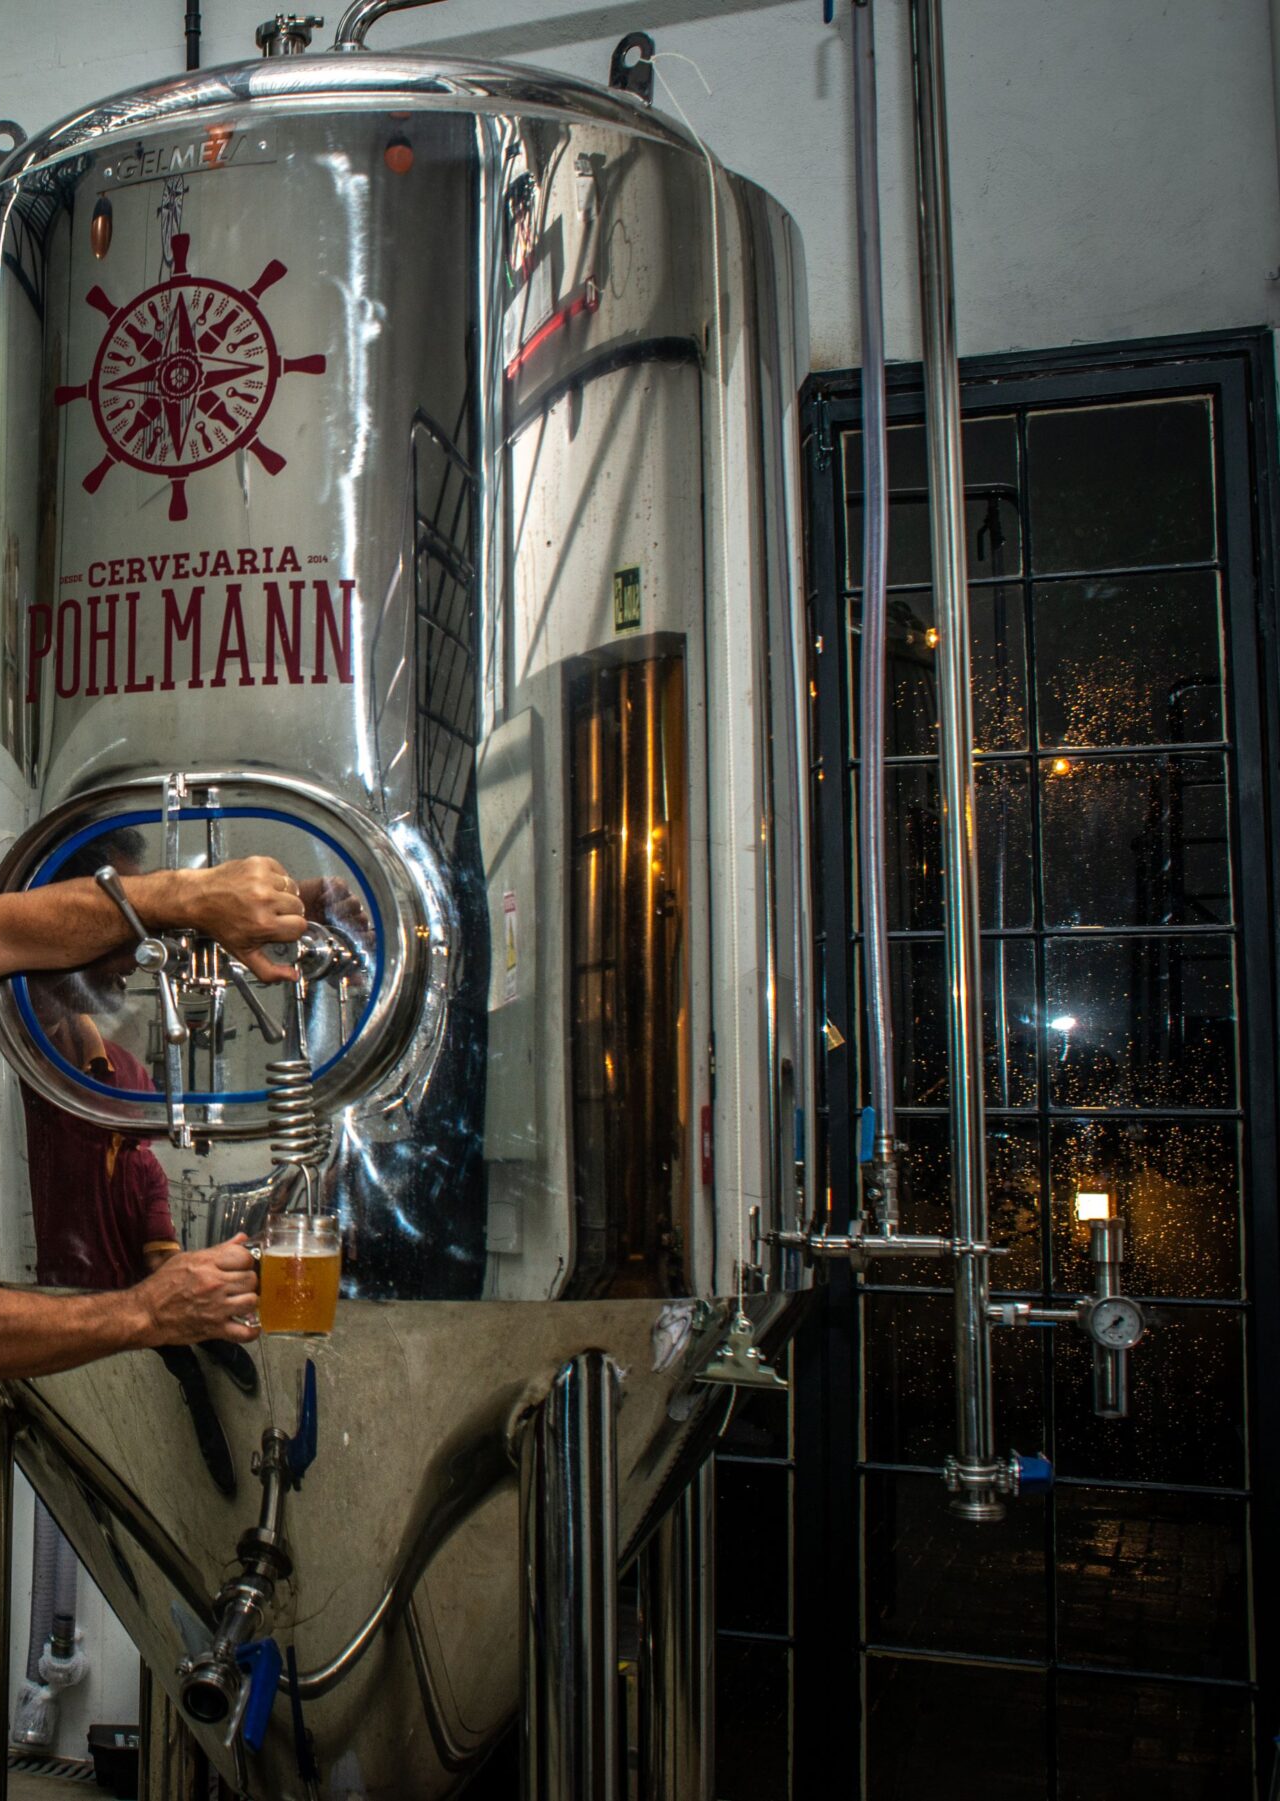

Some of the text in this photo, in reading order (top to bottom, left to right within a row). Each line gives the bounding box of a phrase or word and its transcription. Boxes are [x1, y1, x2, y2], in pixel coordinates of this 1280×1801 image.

[88, 546, 302, 588] CERVEJARIA
[307, 555, 328, 564] 2014
[26, 580, 356, 703] POHLMANN
